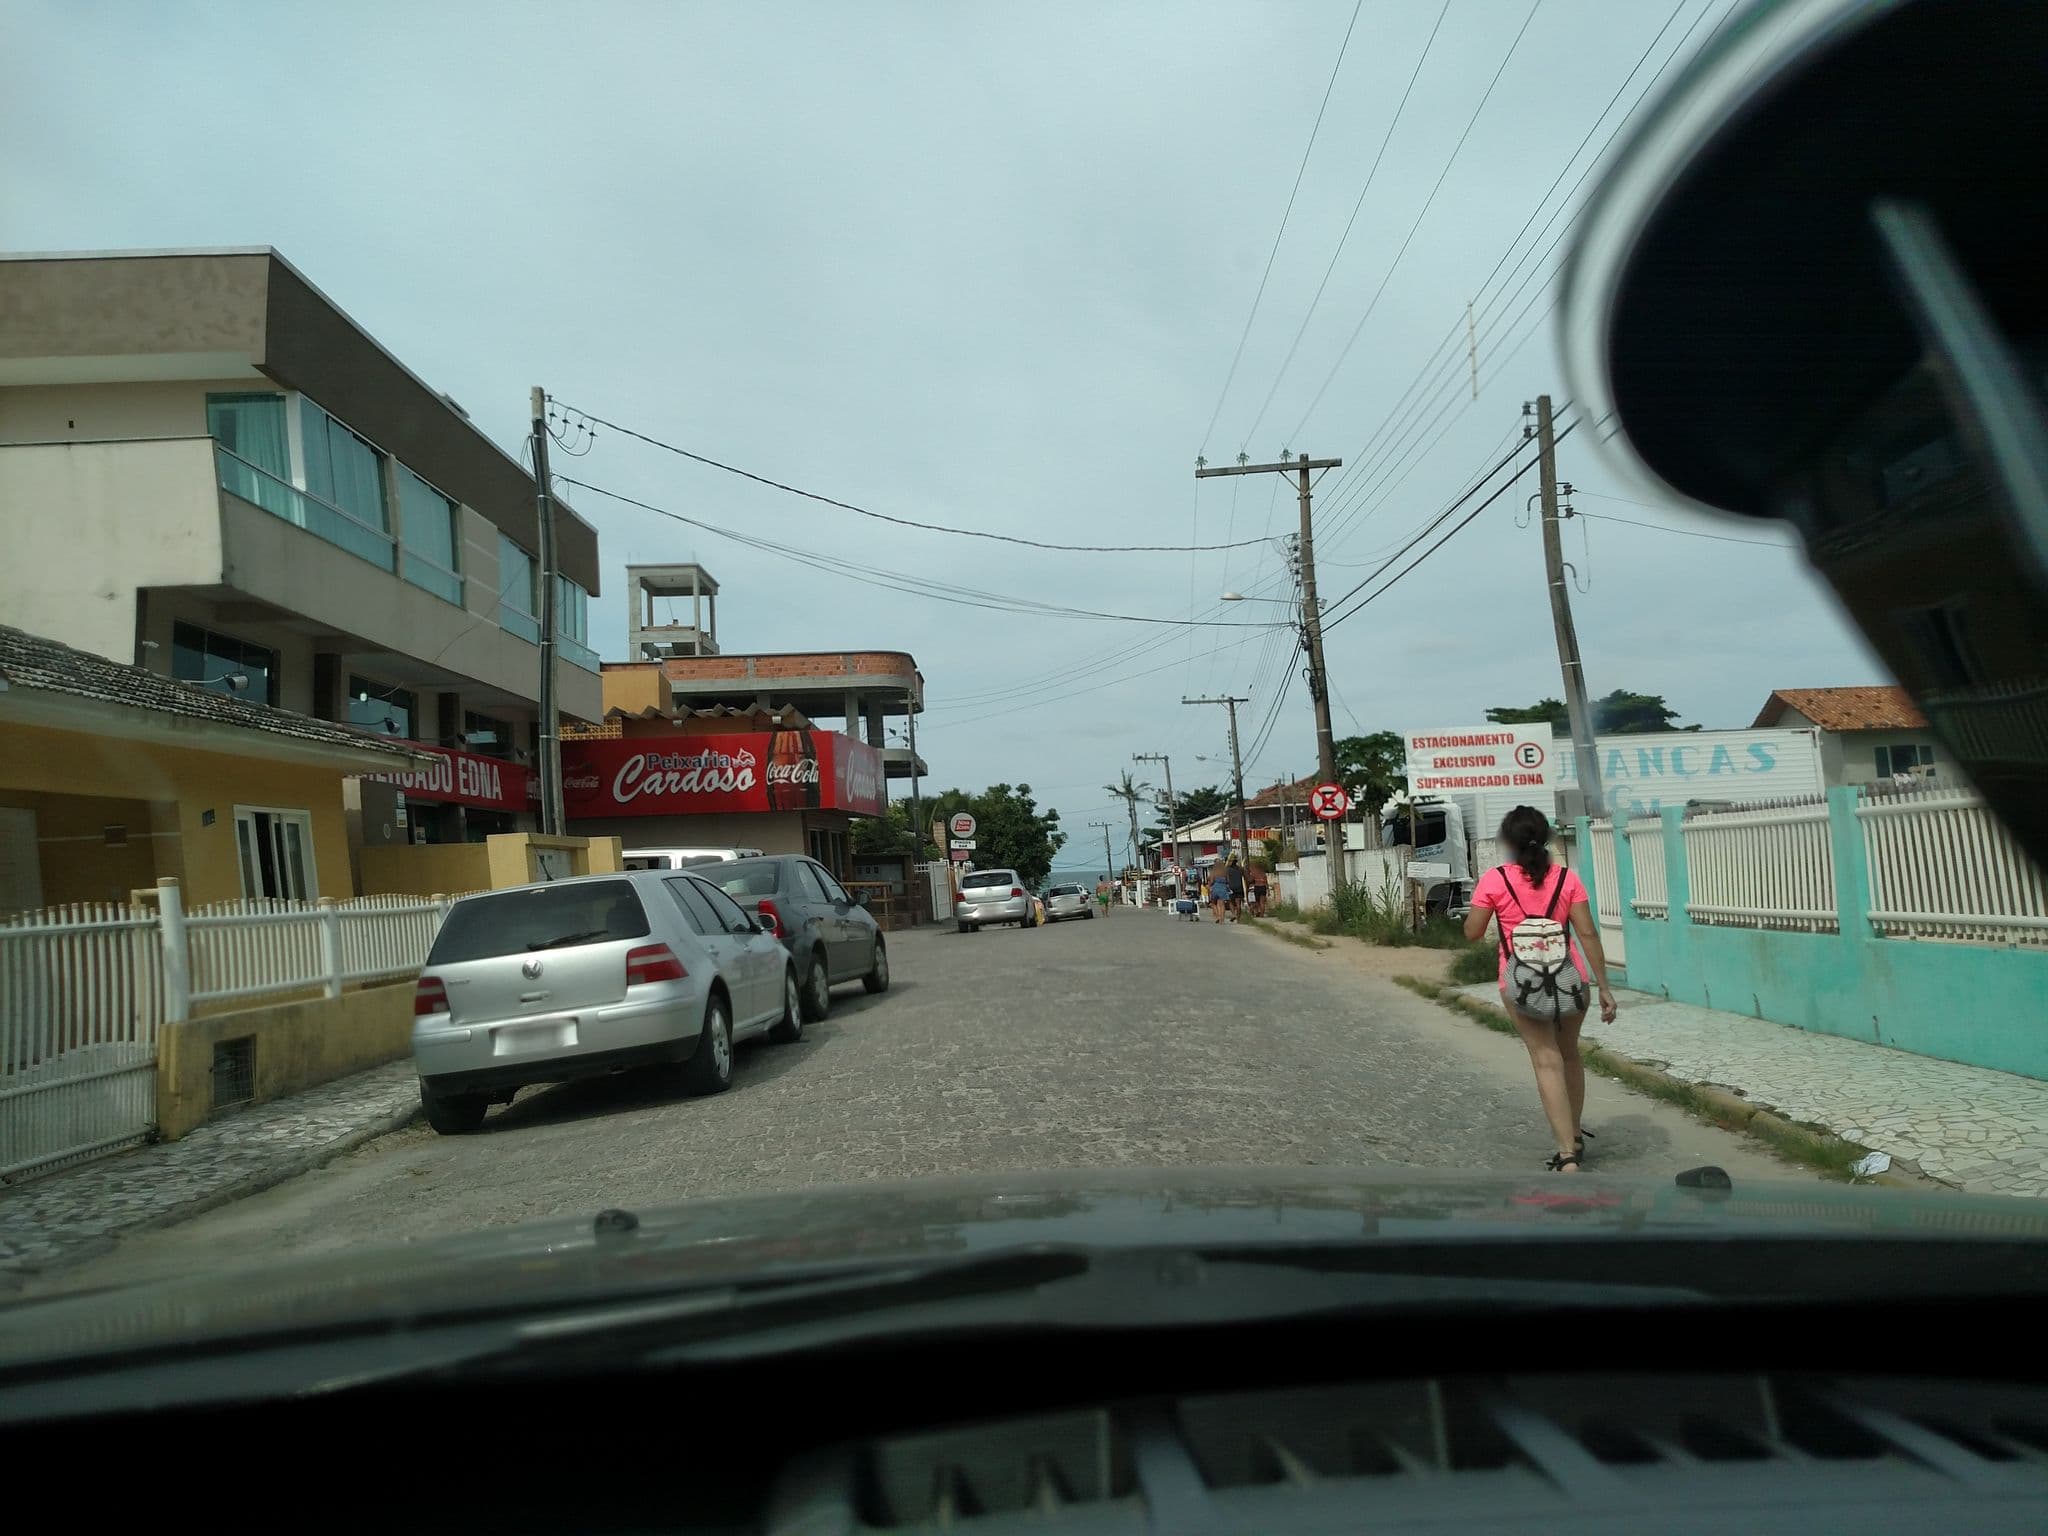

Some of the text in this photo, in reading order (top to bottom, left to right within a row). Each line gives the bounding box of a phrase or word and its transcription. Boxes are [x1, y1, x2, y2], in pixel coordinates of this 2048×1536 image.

[1412, 733, 1515, 749] ESTACIONAMENTO
[646, 750, 731, 771] Peixaria
[1433, 755, 1496, 769] EXCLUSIVO
[1523, 748, 1535, 763] E
[458, 756, 503, 801] EDNA
[612, 750, 757, 803] Cardoso
[767, 757, 819, 784] Coca-Cola
[1416, 773, 1544, 789] SUPERMERCADO EDNA
